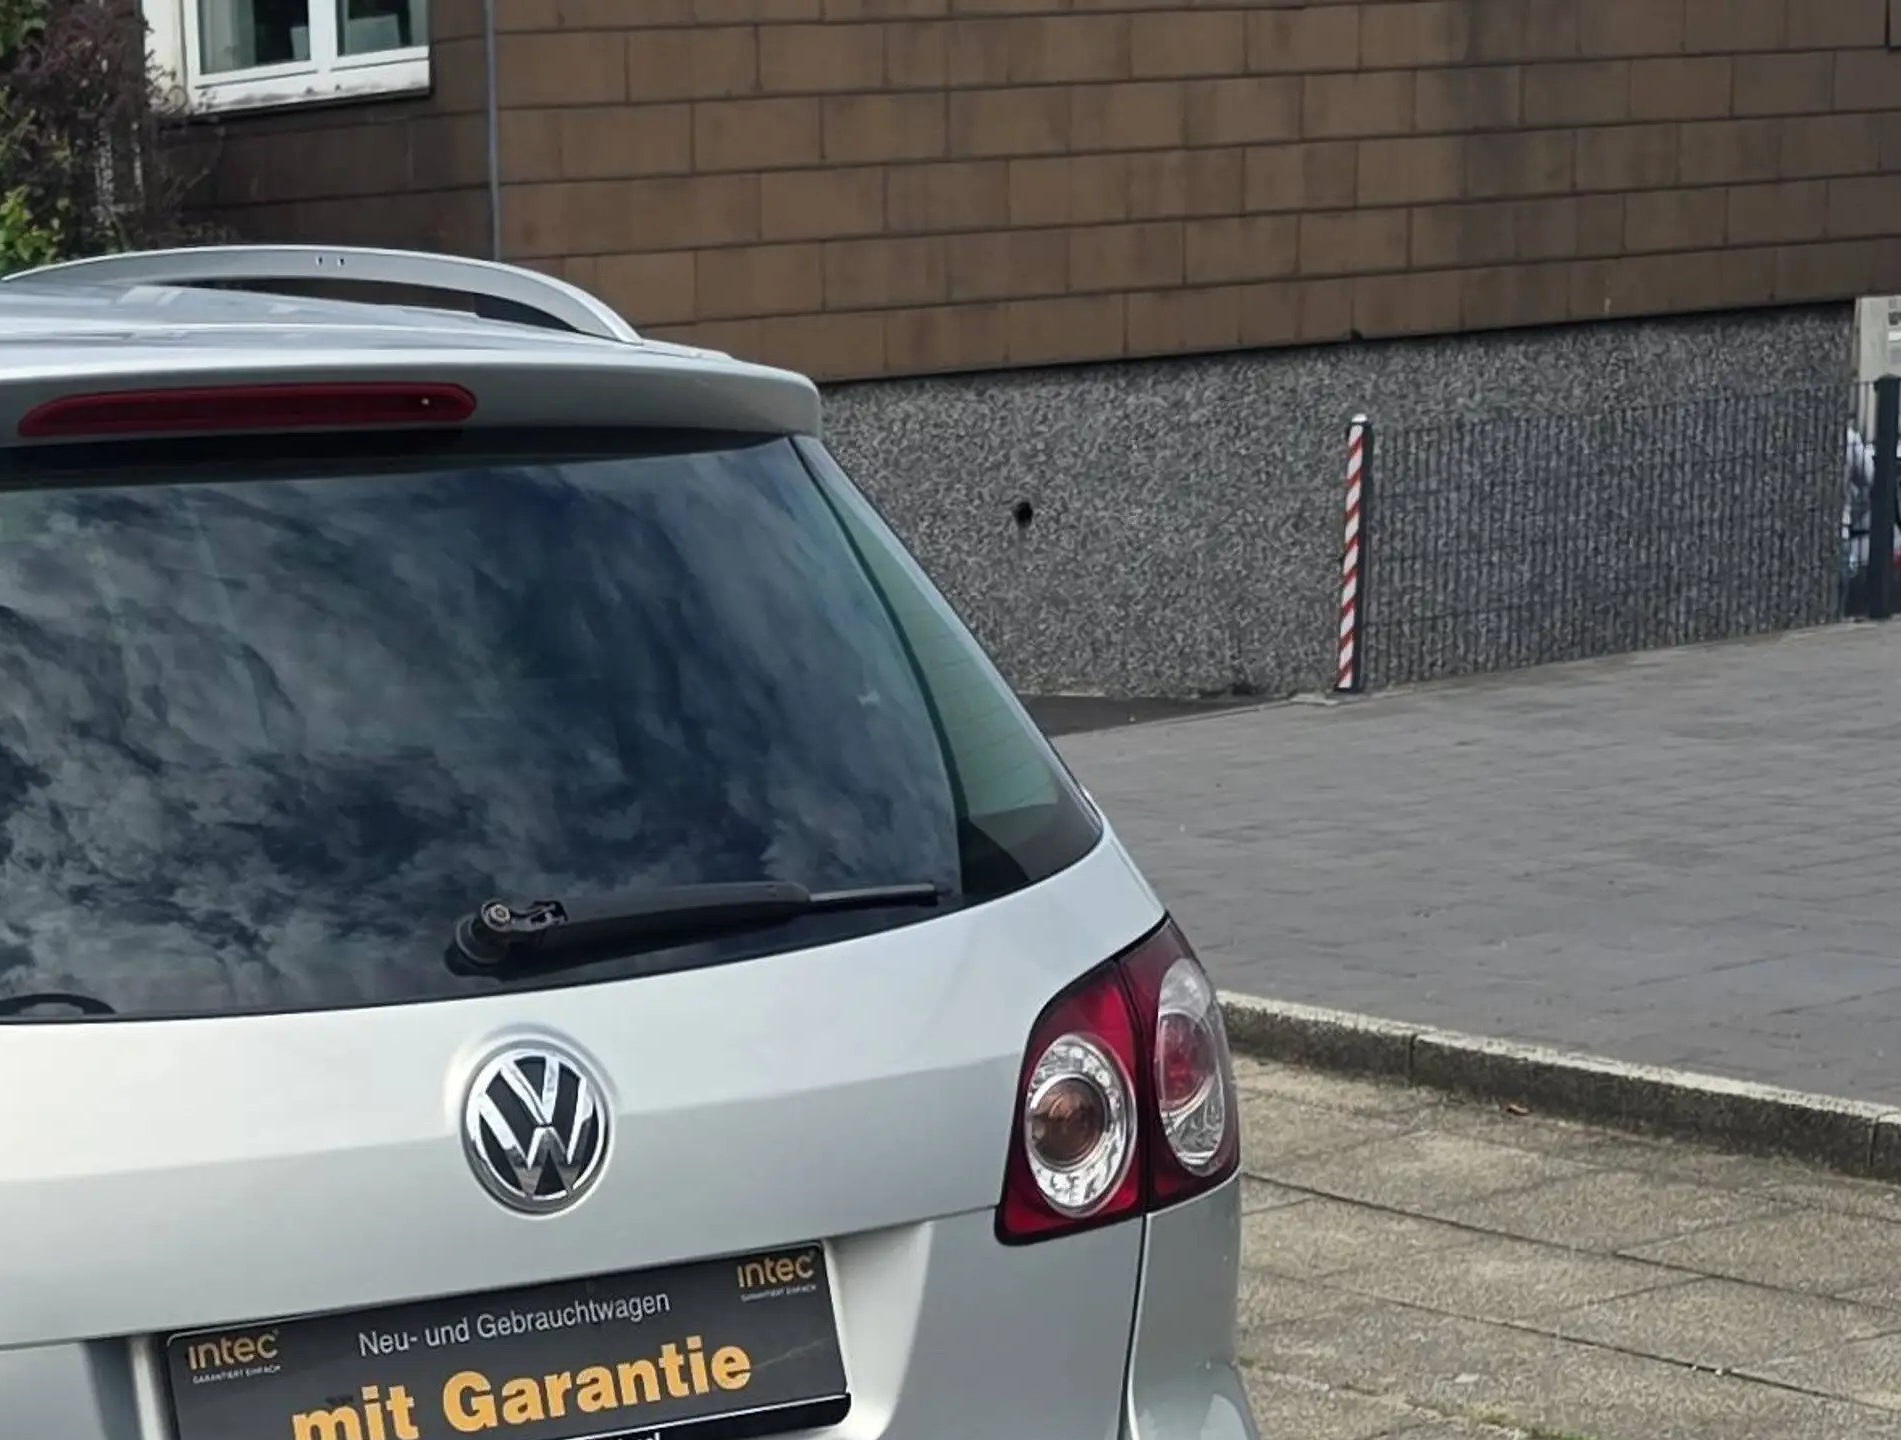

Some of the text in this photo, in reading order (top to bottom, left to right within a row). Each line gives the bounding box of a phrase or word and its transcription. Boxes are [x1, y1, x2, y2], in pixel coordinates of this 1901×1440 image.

[358, 1292, 671, 1357] Neu- und Gebrauchtwagen
[441, 1334, 753, 1433] Garantie
